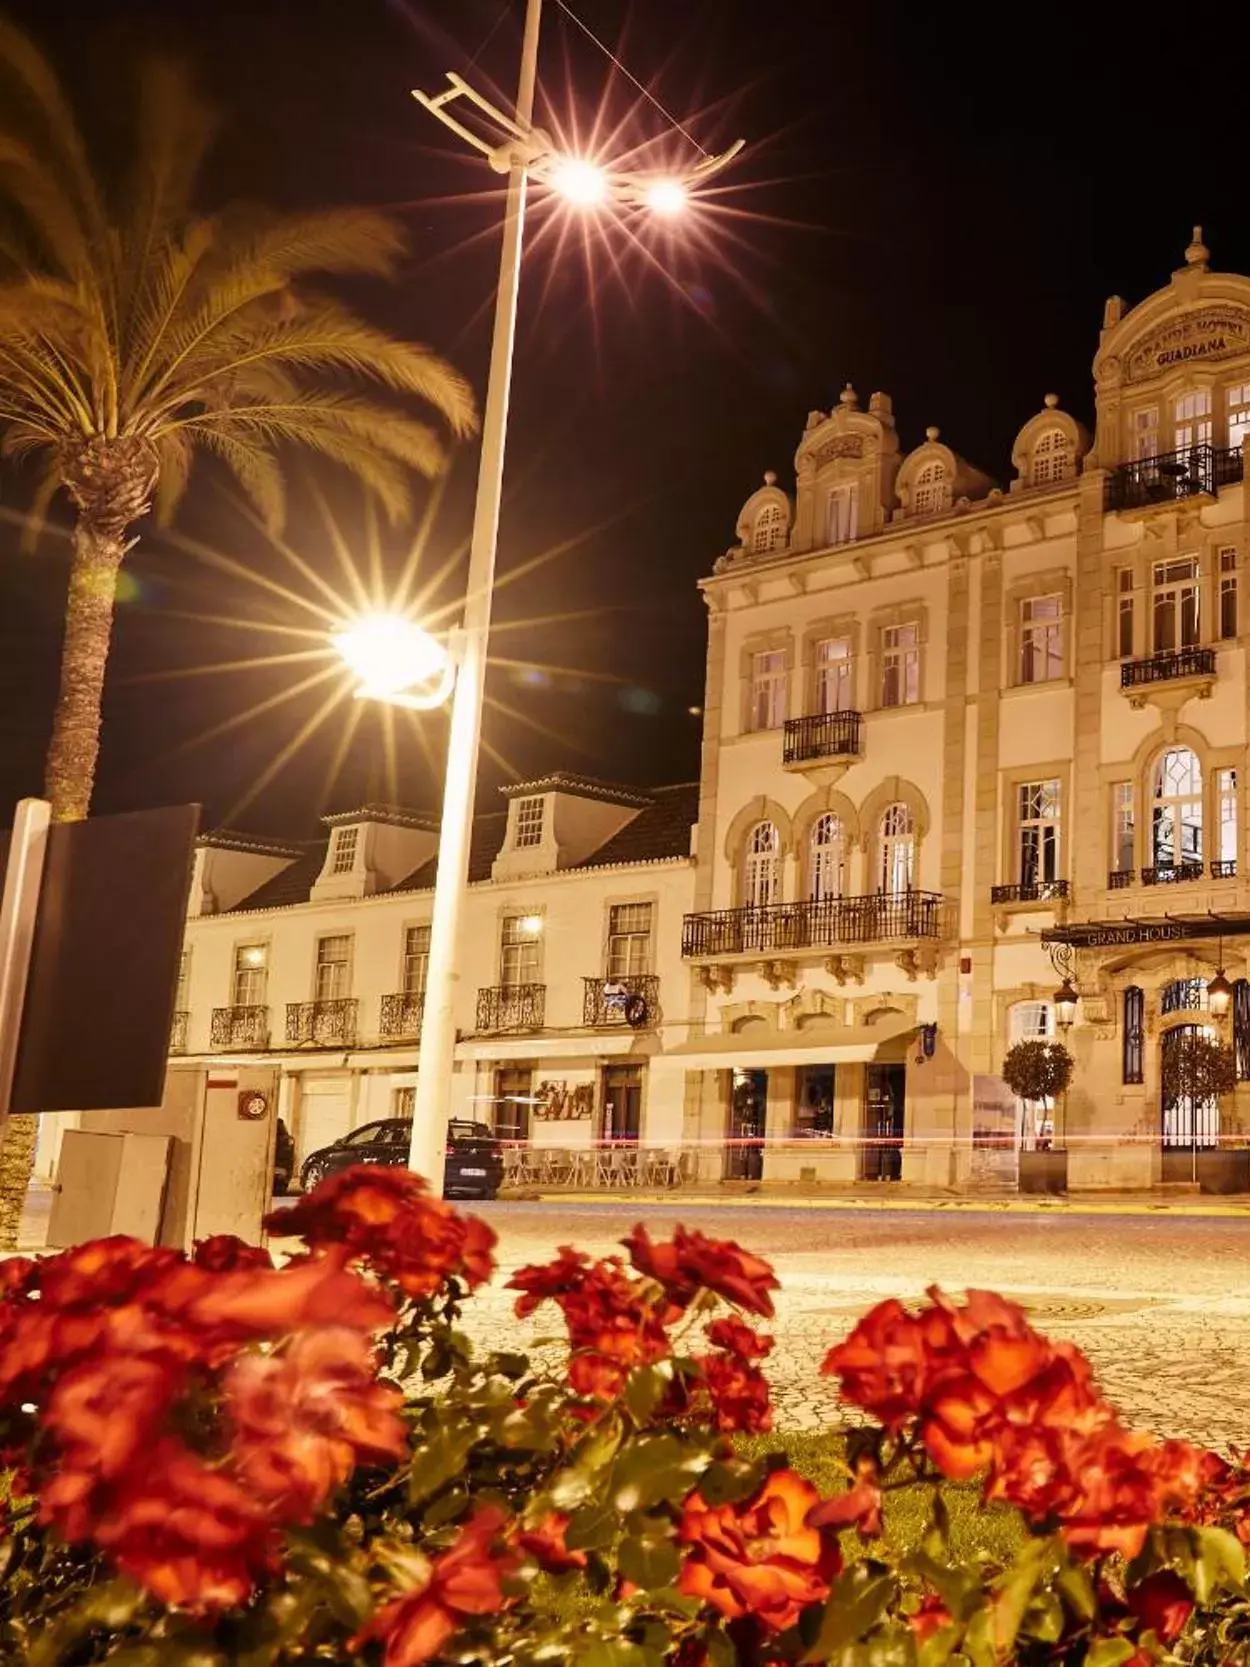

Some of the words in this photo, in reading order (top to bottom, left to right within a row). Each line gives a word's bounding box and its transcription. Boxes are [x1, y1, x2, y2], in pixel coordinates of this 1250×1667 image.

[1157, 337, 1226, 366] GUADIANA
[1087, 929, 1136, 946] GRAND
[1139, 924, 1193, 942] HOUSE
